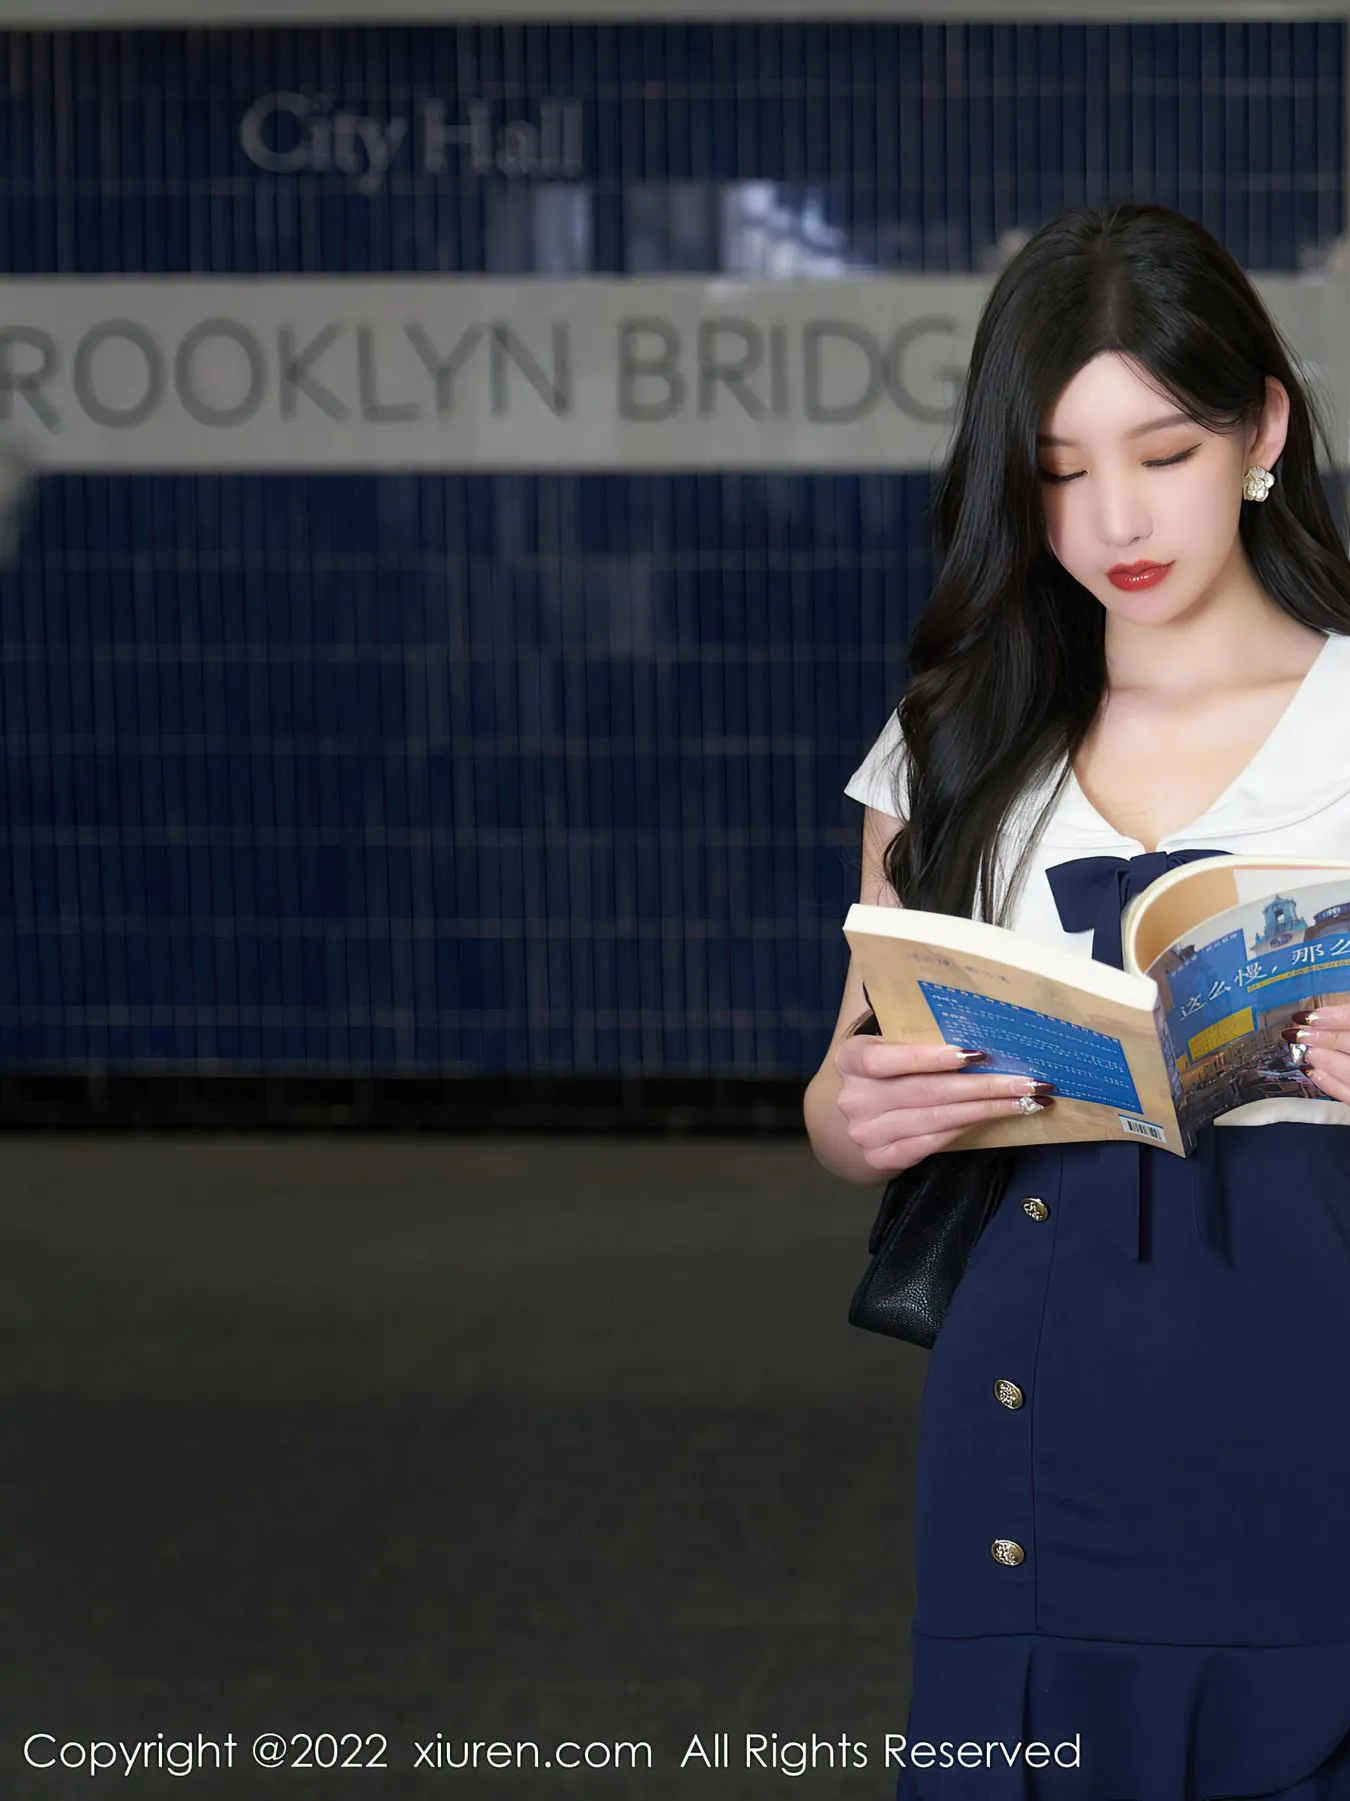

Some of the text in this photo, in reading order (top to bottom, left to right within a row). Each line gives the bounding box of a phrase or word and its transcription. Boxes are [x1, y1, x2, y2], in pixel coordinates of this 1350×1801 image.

[240, 90, 584, 194] City Hall
[0, 314, 967, 434] ROOKLYN BRIDG
